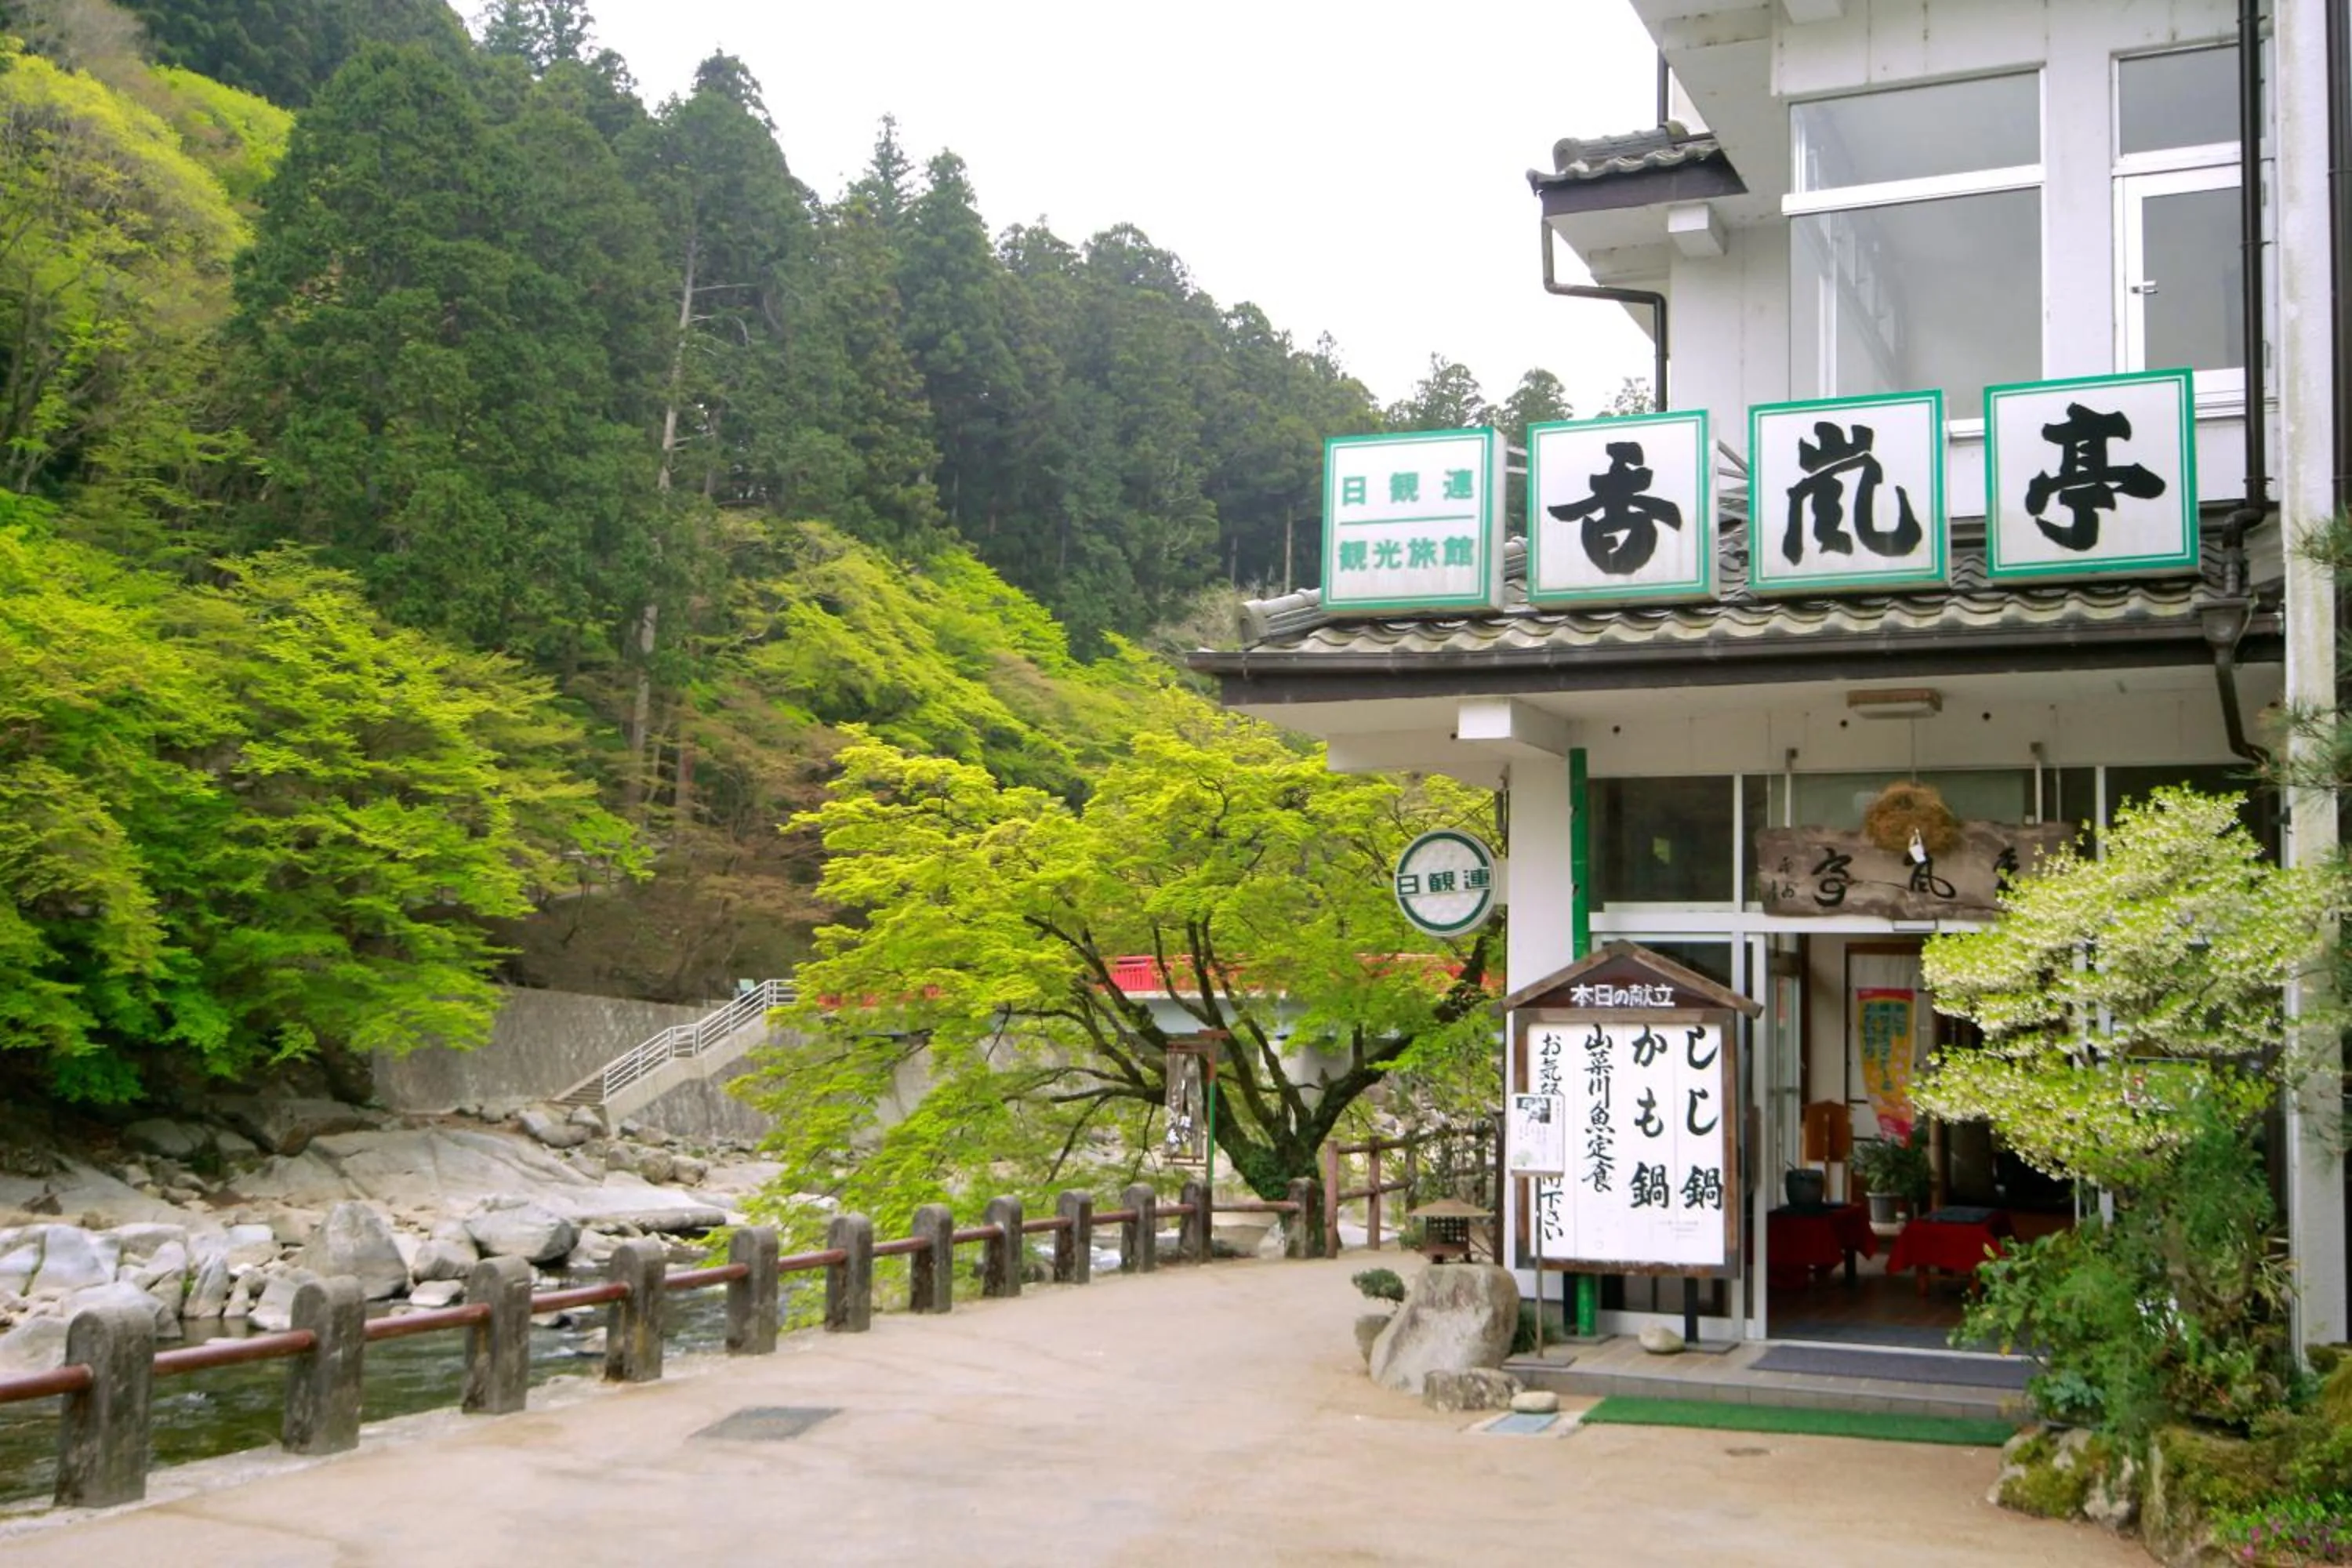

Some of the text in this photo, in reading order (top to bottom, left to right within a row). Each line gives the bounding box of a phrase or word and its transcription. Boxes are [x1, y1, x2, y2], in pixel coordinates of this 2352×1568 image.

[1342, 468, 1475, 506] 日観連
[1548, 401, 2165, 575] 香嵐亭
[1339, 535, 1475, 572] 観光旅館
[1570, 982, 1675, 1007] 本日の献立
[1581, 1023, 1616, 1192] 山菜川魚定食
[1631, 1024, 1669, 1209] かも鍋
